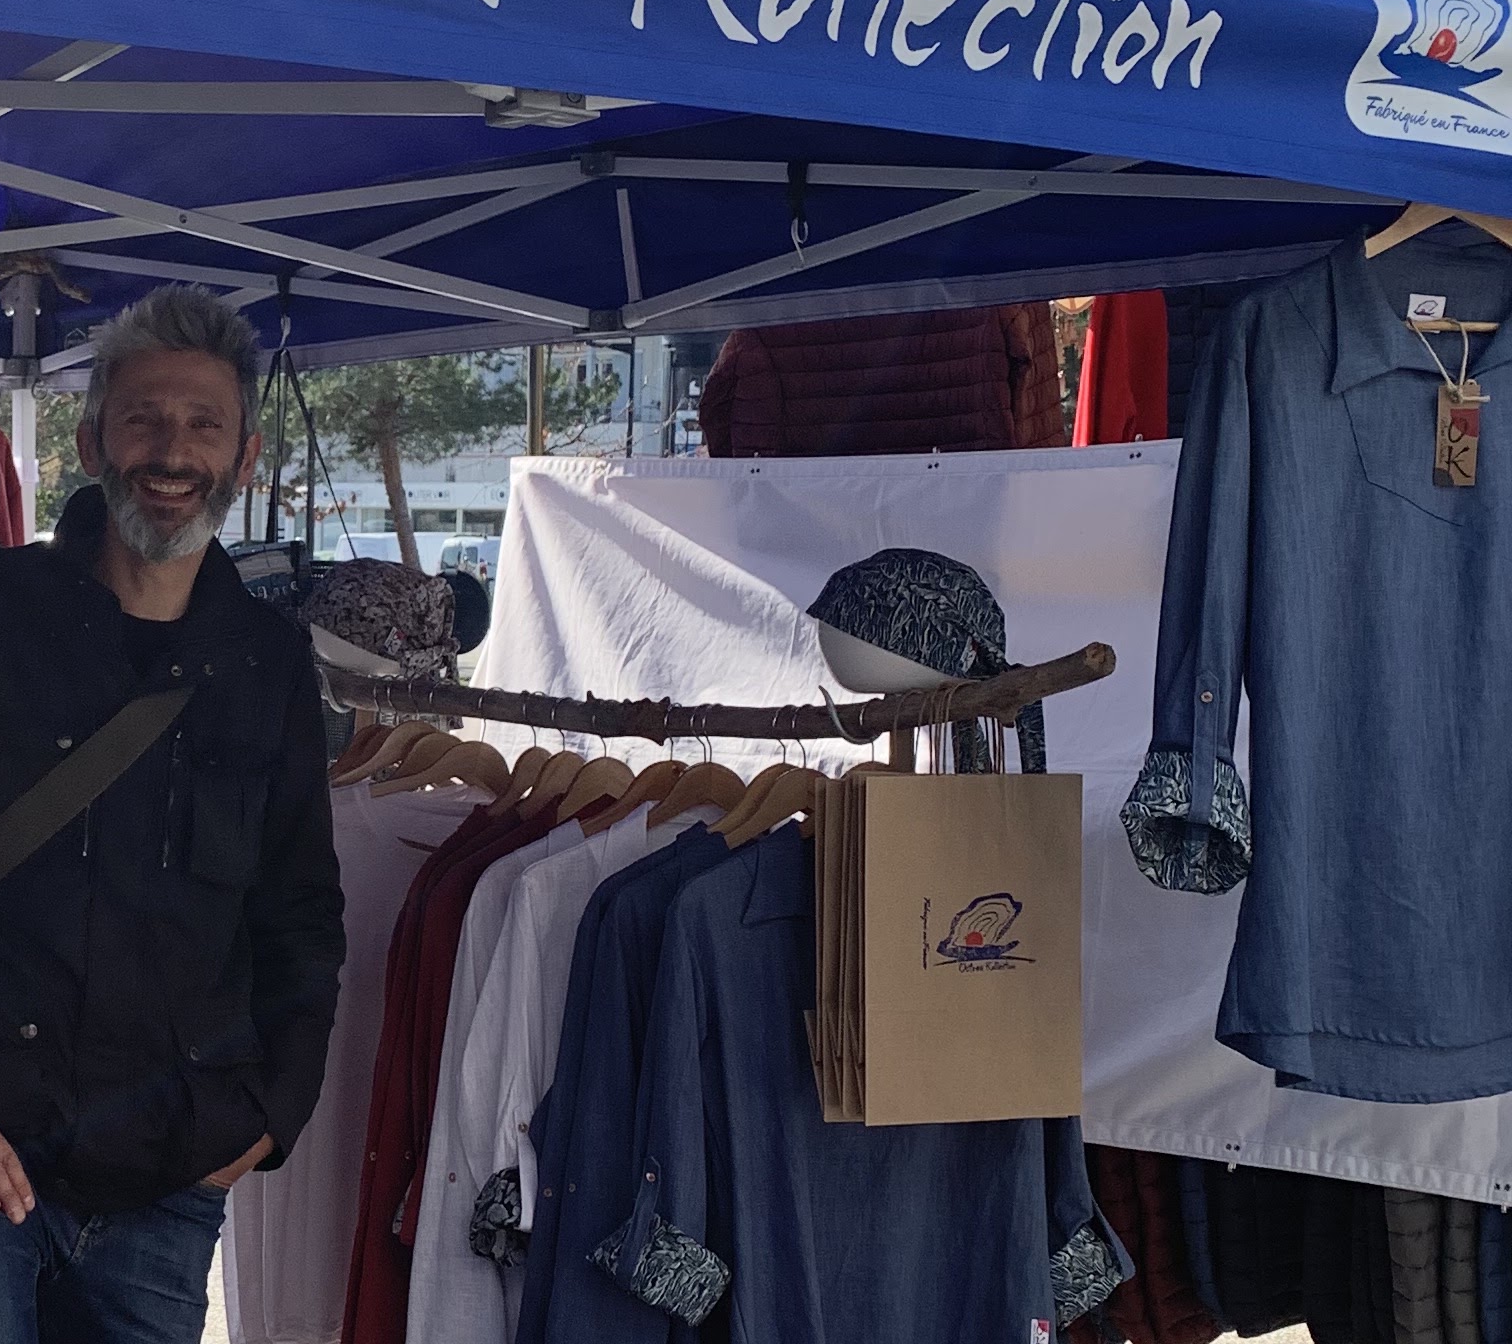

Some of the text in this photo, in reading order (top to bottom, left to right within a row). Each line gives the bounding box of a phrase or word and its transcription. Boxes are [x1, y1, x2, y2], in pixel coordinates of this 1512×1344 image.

[1365, 95, 1511, 139] Fabriqué en France
